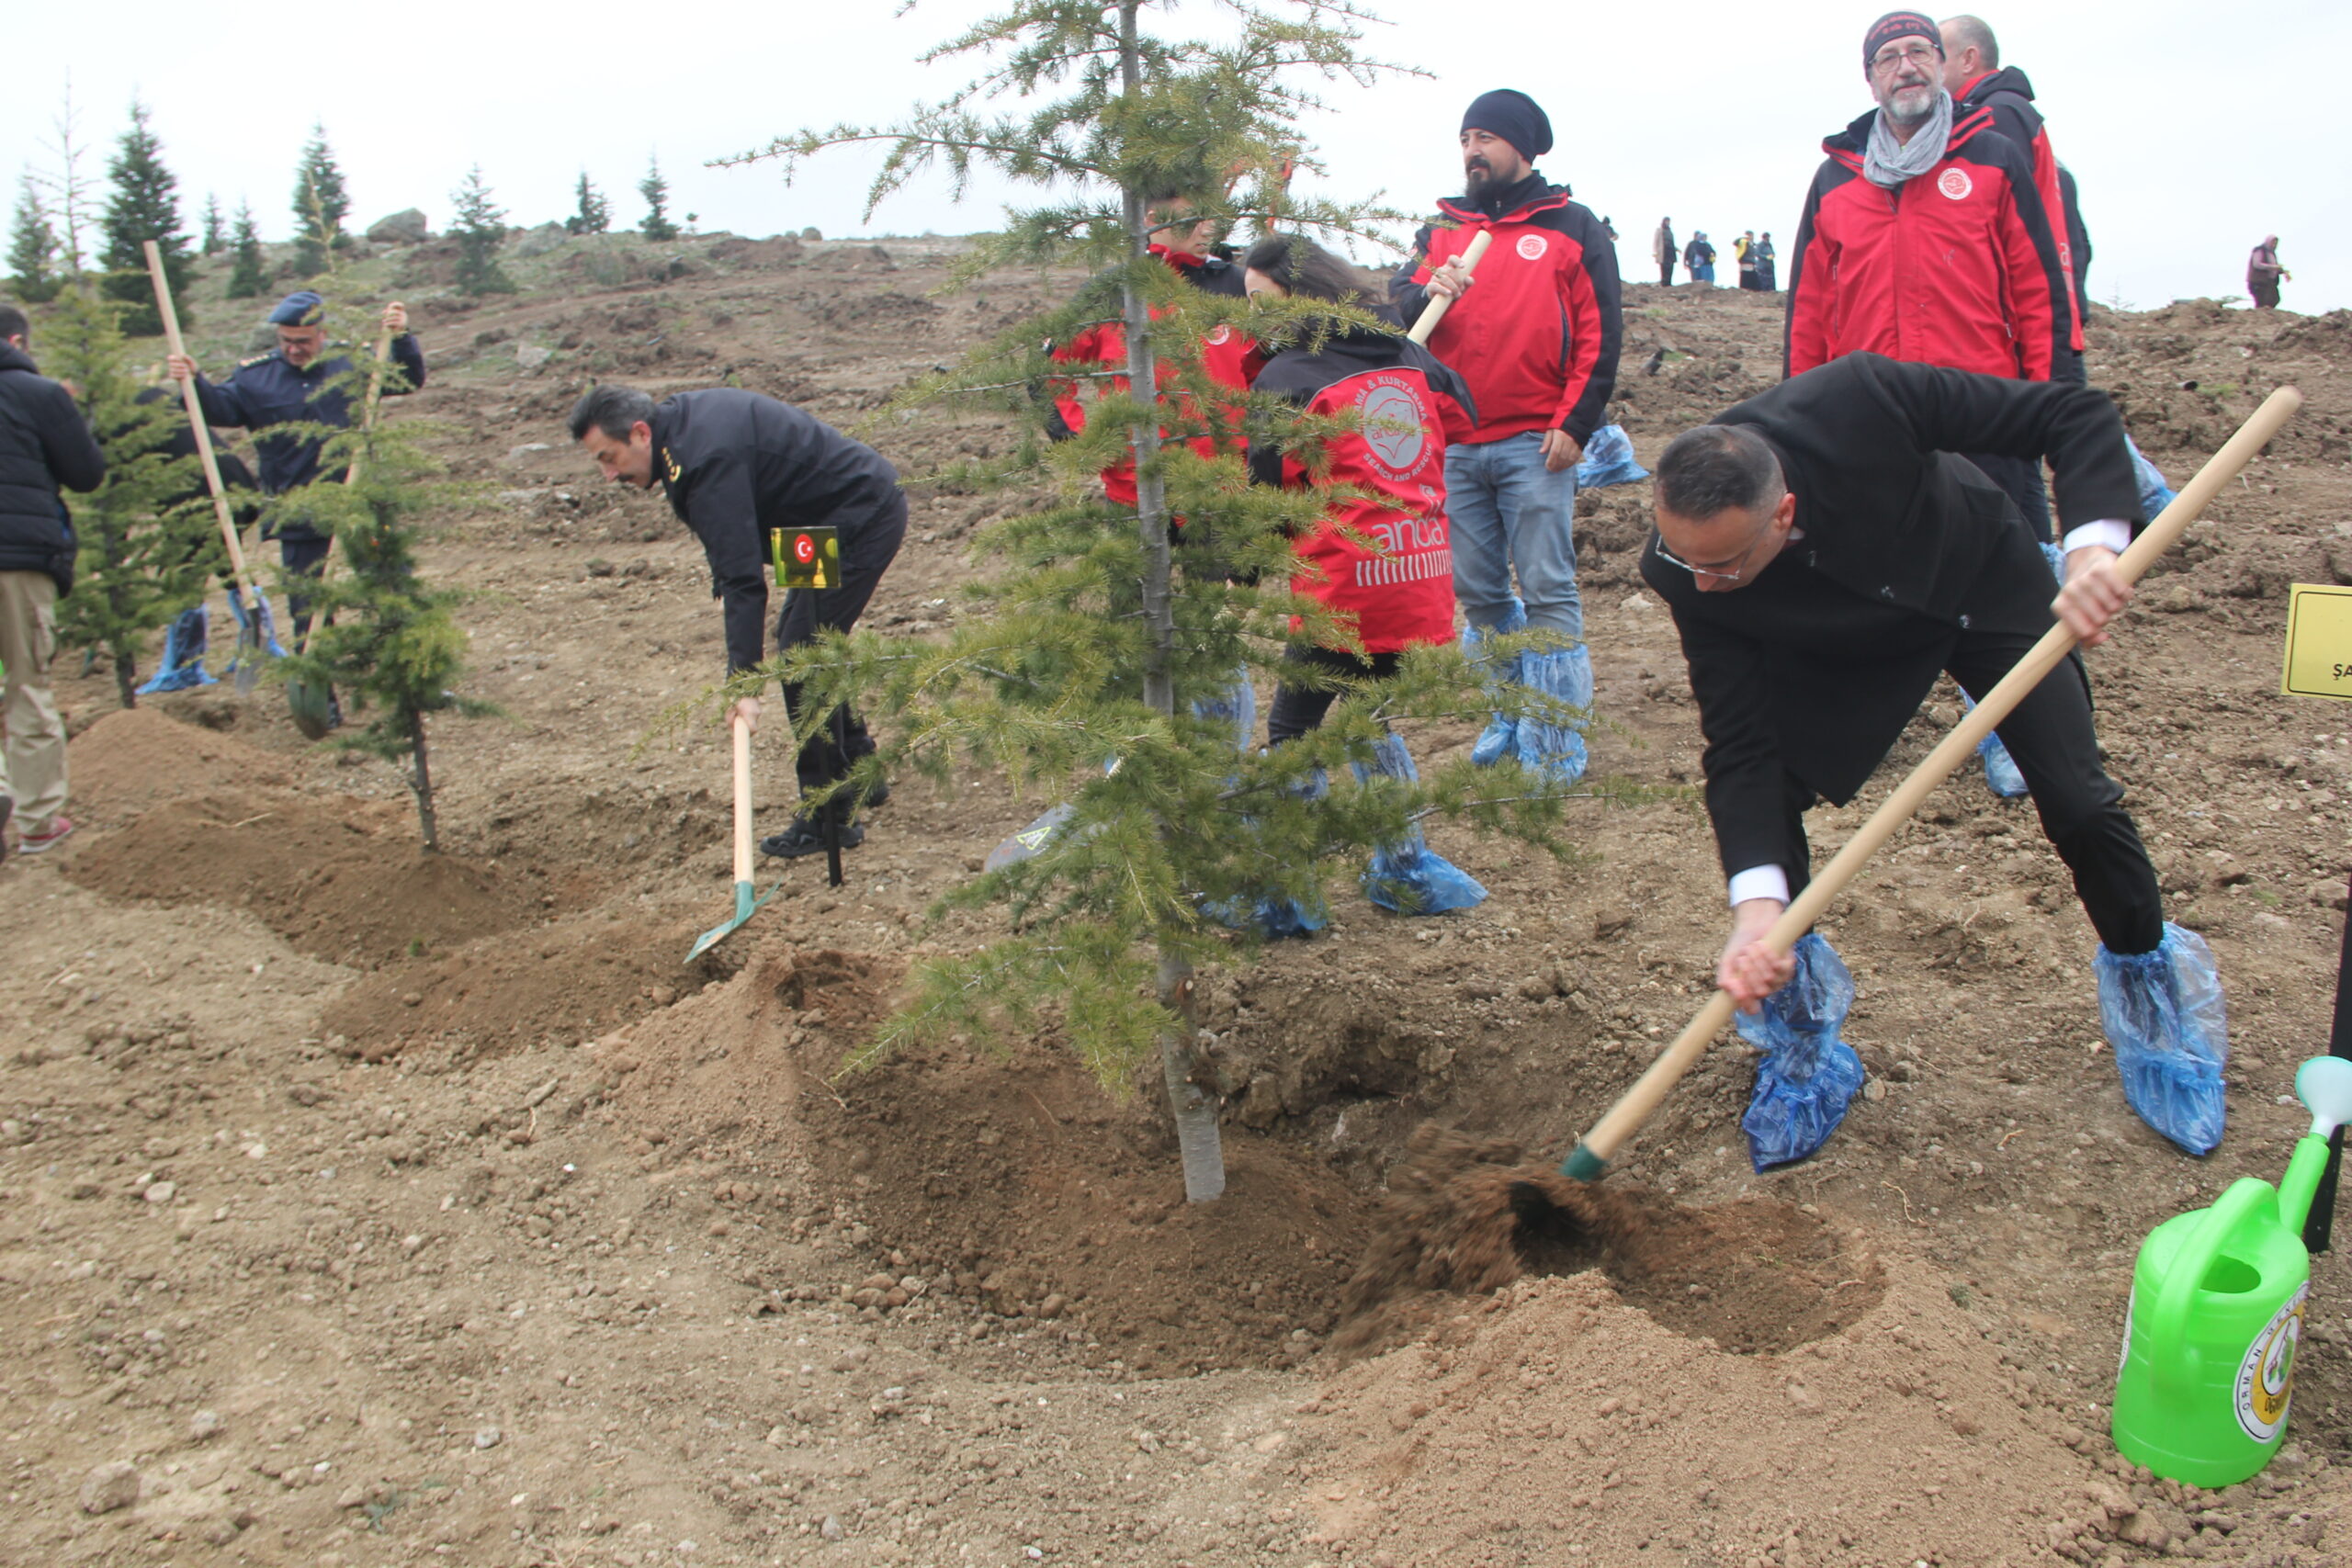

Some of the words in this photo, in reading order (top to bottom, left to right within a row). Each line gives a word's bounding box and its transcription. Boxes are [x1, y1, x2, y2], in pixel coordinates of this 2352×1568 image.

[1363, 453, 1394, 481] SEARCH
[1394, 472, 1411, 482] AND
[1411, 442, 1432, 478] RESCUE
[2242, 1348, 2263, 1411] ORMAN
